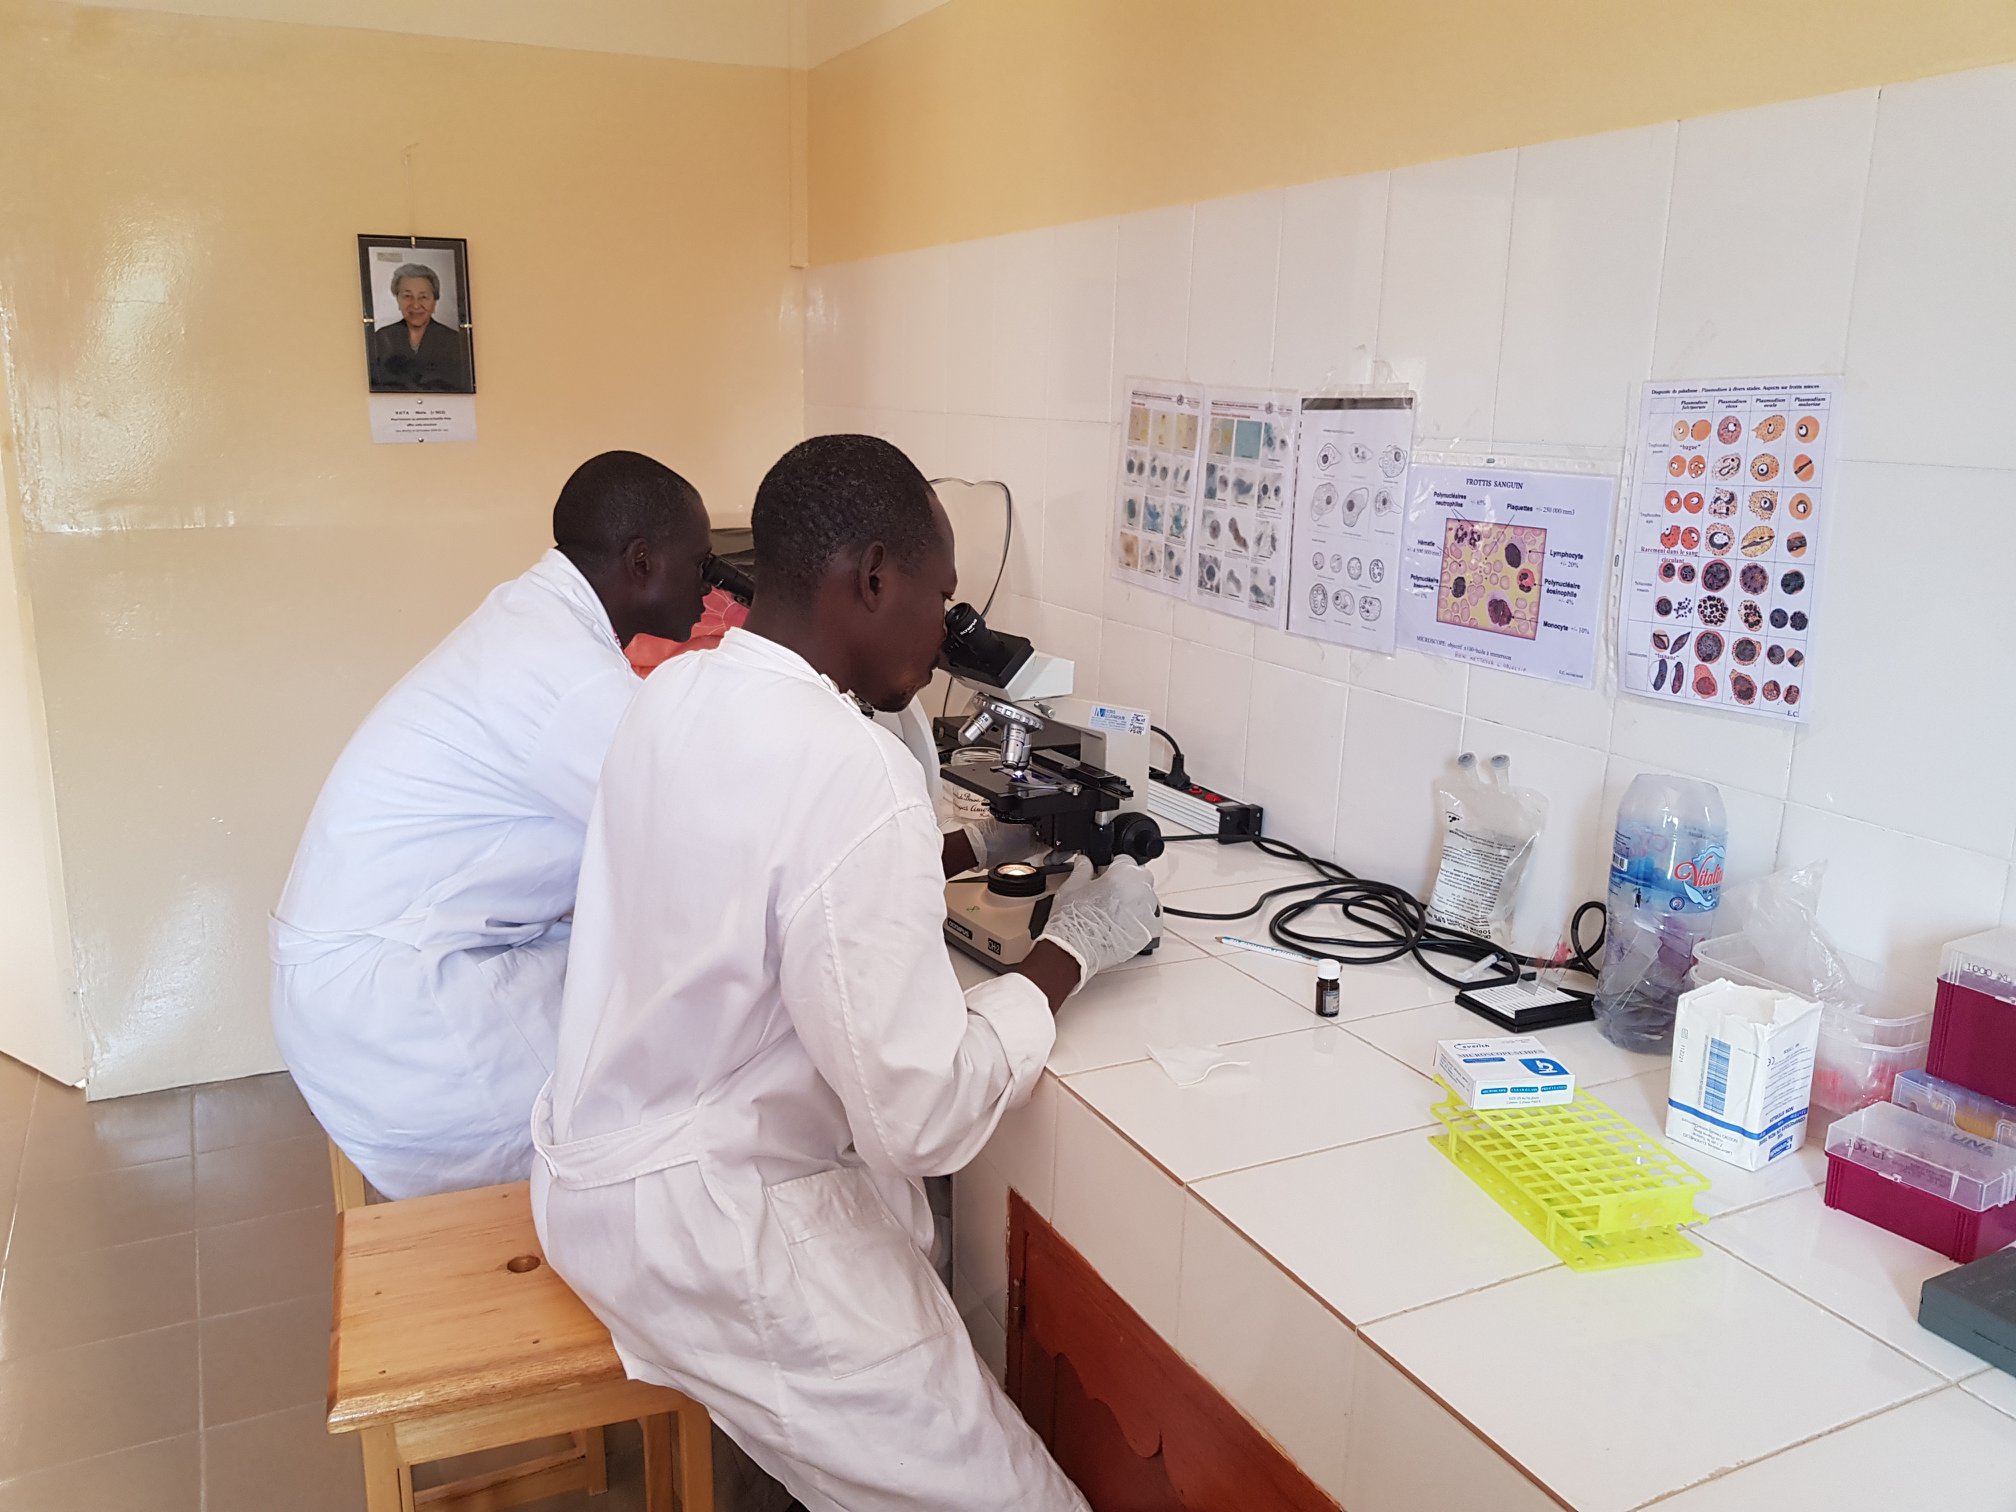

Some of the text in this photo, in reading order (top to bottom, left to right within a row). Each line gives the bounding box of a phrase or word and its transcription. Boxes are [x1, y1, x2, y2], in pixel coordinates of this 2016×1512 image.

[1466, 479, 1523, 489] FROTTIS SANGUIN
[1434, 491, 1466, 500] Polynucléaires
[1506, 504, 1533, 512] Plaquettes
[1550, 550, 1584, 560] Lymphocyte
[1544, 578, 1580, 590] Polynucléaire
[1546, 588, 1577, 598] éosinophile
[1543, 621, 1568, 631] Monocyte
[1968, 963, 1992, 976] 1000
